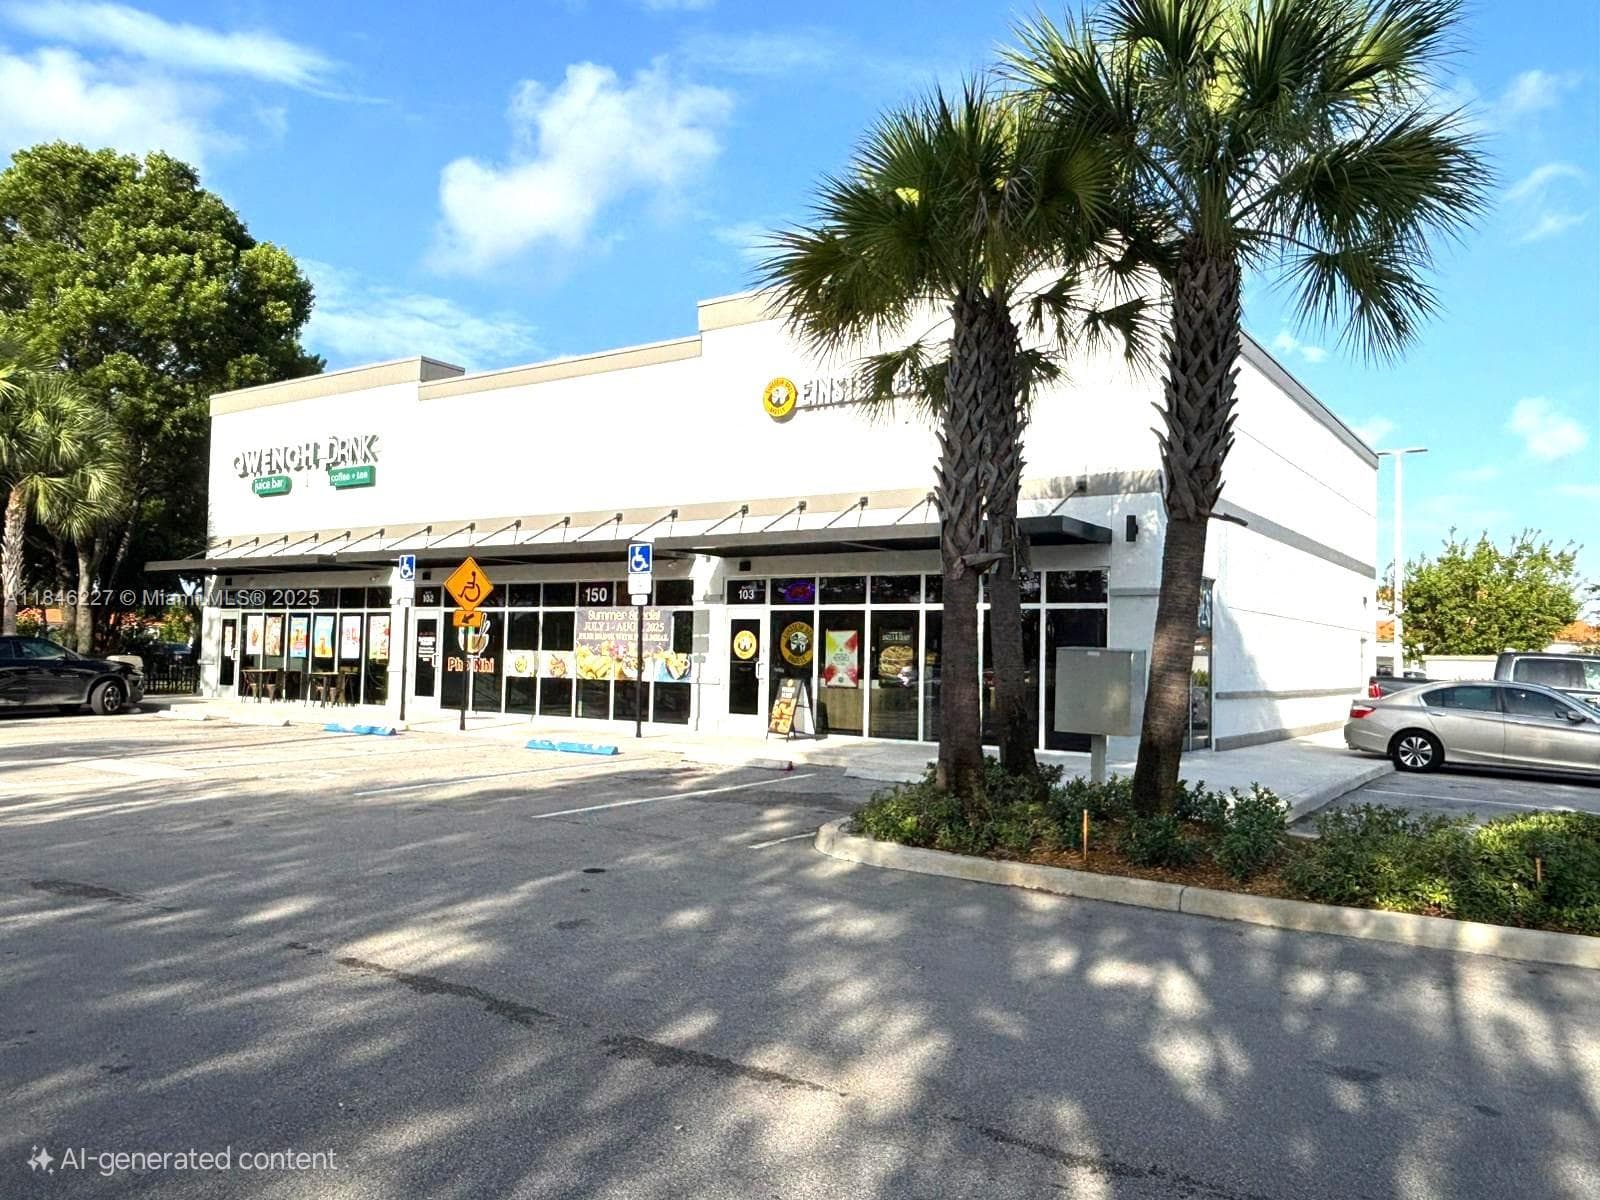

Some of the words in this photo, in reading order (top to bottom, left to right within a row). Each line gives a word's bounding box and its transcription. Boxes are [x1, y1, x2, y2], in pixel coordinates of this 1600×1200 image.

[585, 587, 608, 602] 150
[738, 590, 755, 600] 103
[628, 610, 661, 620] Spial
